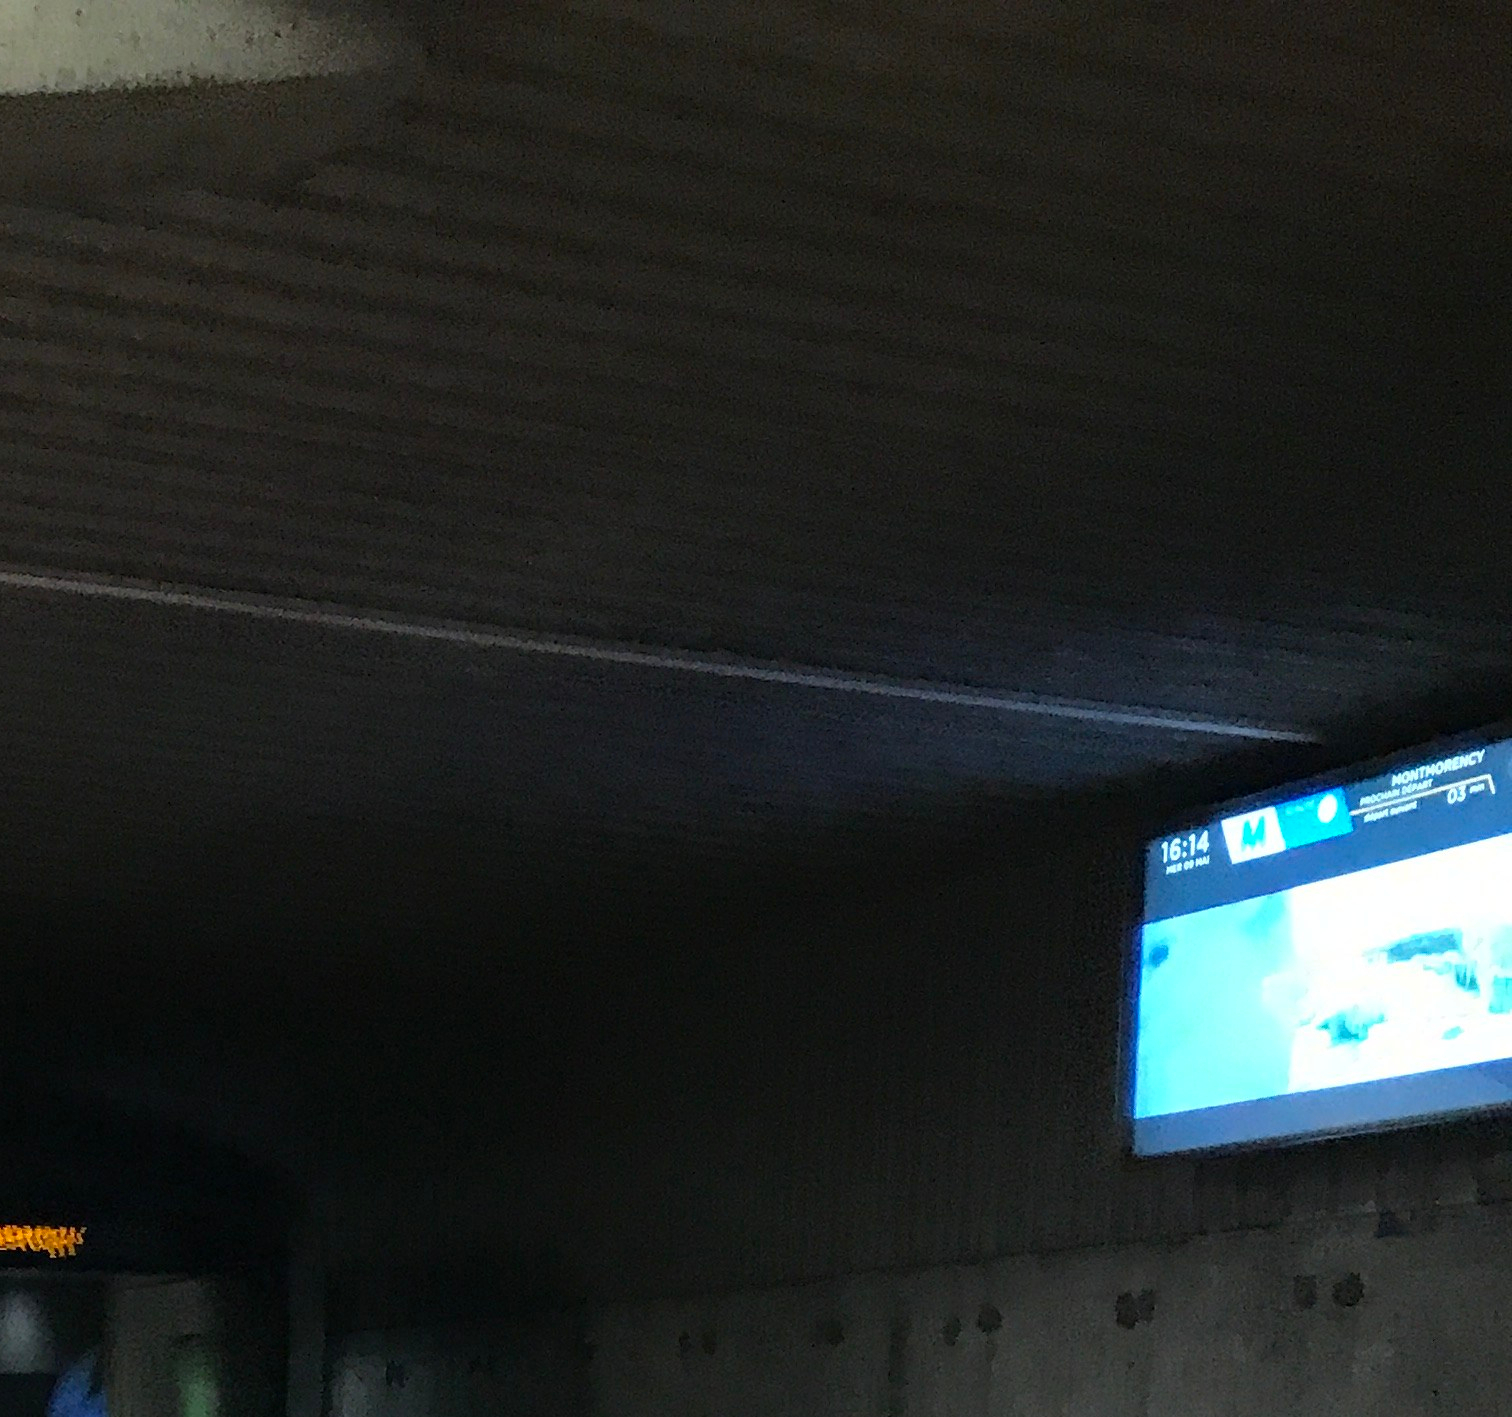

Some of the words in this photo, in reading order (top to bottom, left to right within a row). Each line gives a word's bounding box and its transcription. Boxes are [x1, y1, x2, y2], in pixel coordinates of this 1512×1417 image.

[1391, 749, 1486, 787] MONTMORENCY
[1446, 785, 1467, 805] 03
[1161, 830, 1210, 864] 16:14
